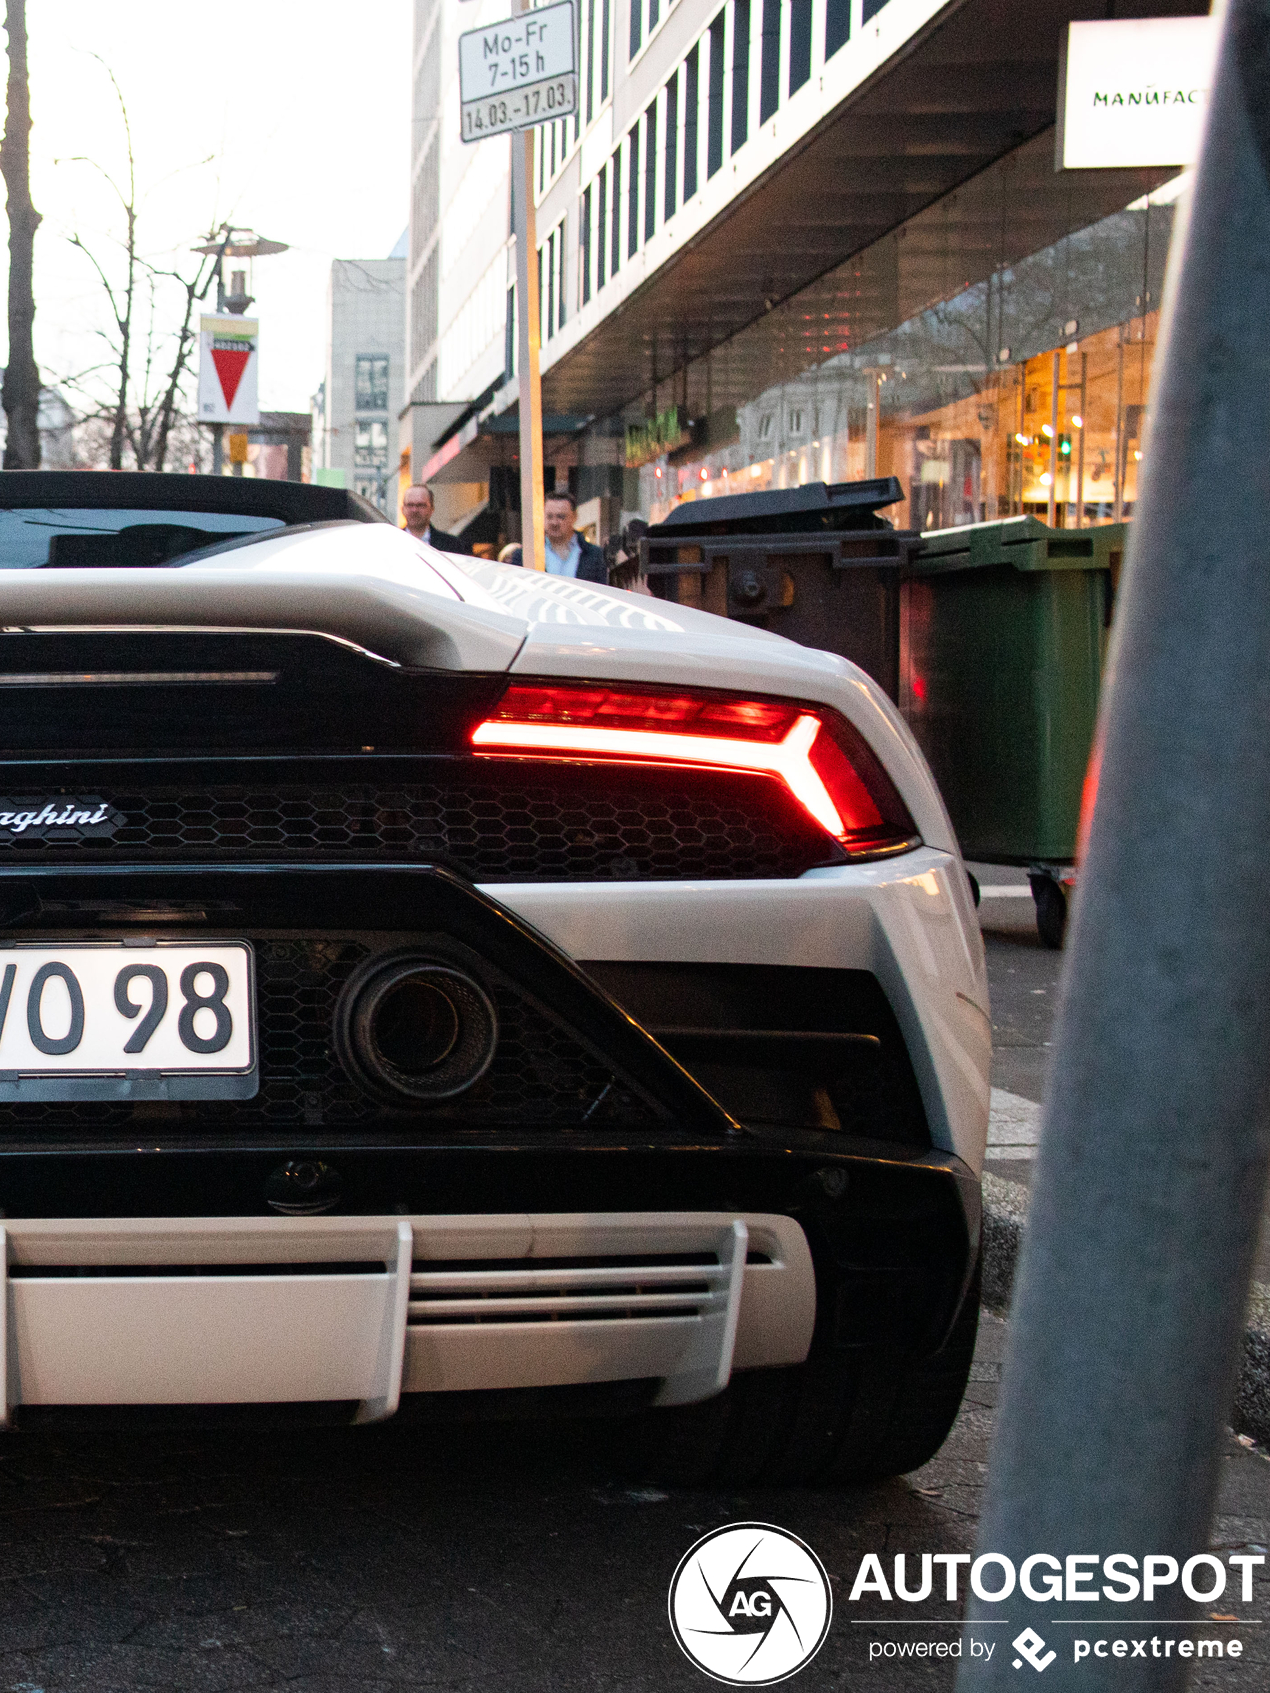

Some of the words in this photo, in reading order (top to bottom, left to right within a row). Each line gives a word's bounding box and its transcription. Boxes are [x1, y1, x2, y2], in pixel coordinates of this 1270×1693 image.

[483, 20, 548, 60] Mo-Fr
[488, 53, 529, 87] 7-15
[535, 50, 545, 73] h
[466, 82, 572, 134] 14.03.-17.03.
[114, 961, 234, 1054] 98
